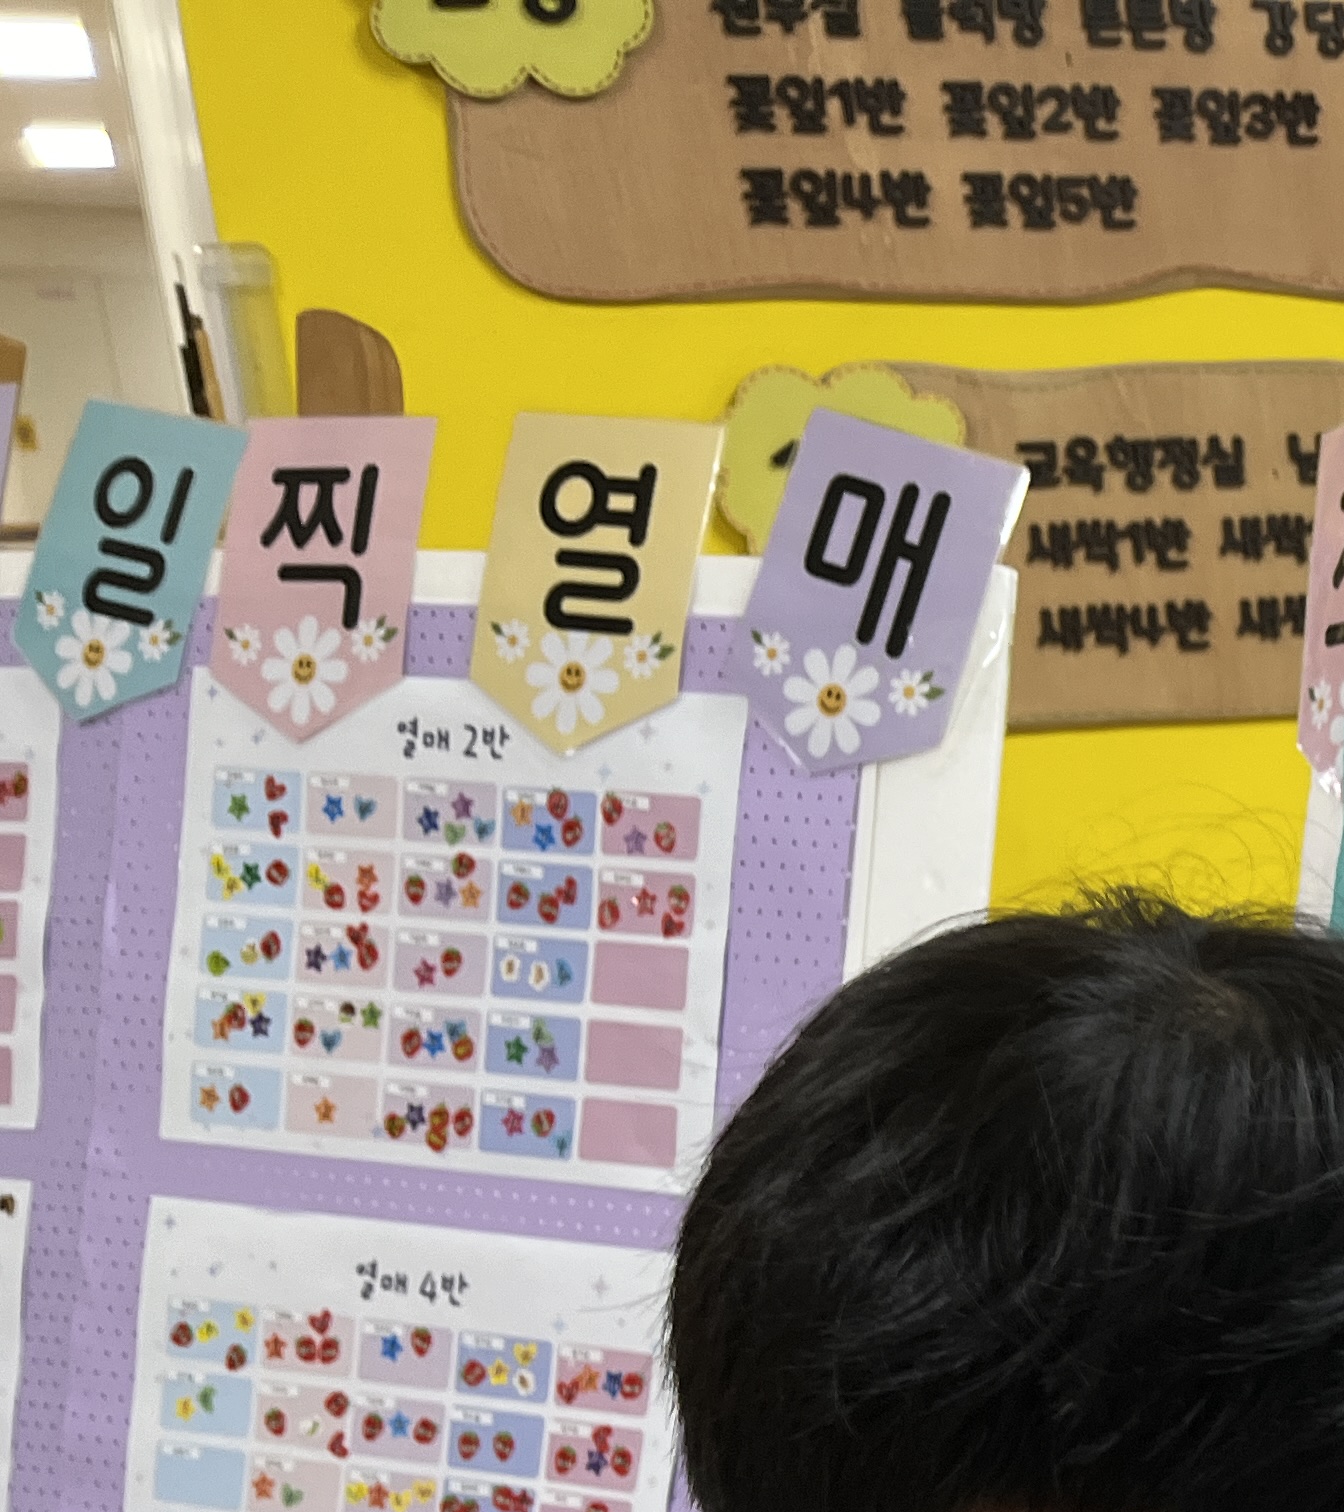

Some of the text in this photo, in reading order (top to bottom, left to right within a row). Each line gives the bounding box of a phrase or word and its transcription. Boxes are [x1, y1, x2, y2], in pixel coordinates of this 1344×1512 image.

[726, 74, 1321, 147] 꽃잎1반 꽃잎2반 꽃잎3반
[740, 168, 1137, 231] 꽃잎4반 꽃잎5반
[1015, 434, 1245, 492] 교육행정실
[1027, 513, 1313, 572] 새싹1반 새싹
[1038, 599, 1213, 657] 새싹4반
[397, 717, 512, 762] 열매 2반
[355, 1260, 470, 1308] 열매 4반
